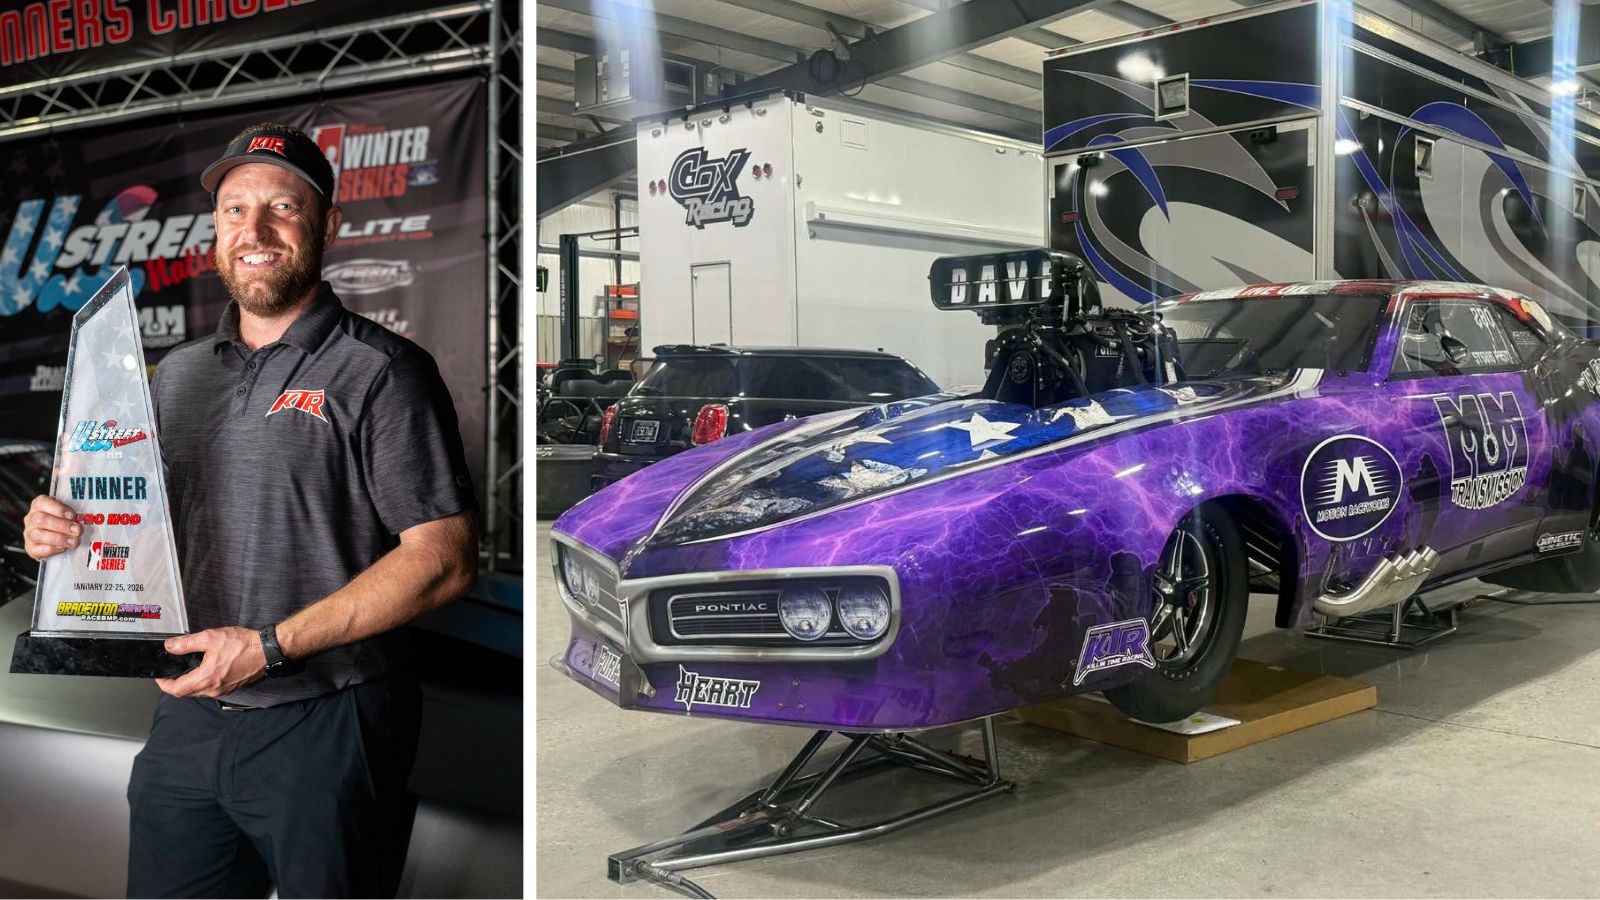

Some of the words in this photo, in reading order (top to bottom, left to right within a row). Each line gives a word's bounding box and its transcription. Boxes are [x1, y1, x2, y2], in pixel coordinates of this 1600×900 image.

[342, 126, 430, 170] WINTER
[338, 163, 410, 203] SERIES
[684, 196, 755, 229] Racing
[337, 215, 432, 238] LITE
[55, 213, 217, 268] STREE
[265, 389, 329, 424] KTR
[88, 428, 142, 440] STREET
[69, 476, 147, 500] WINNER
[1451, 467, 1527, 510] TRANSMISSION
[107, 513, 142, 525] MOD
[1316, 505, 1348, 523] MOTION
[1348, 497, 1390, 516] RACEWORKS
[102, 546, 130, 559] WINTER
[101, 559, 126, 571] SERIES
[73, 583, 102, 592] JANUARY
[104, 583, 126, 592] 22-25,
[127, 583, 144, 592] 2026
[56, 602, 118, 616] BRADENTON
[695, 603, 768, 612] PONTIAC
[1077, 620, 1150, 678] KTR
[1122, 653, 1144, 662] RACING
[675, 664, 760, 711] HEART
